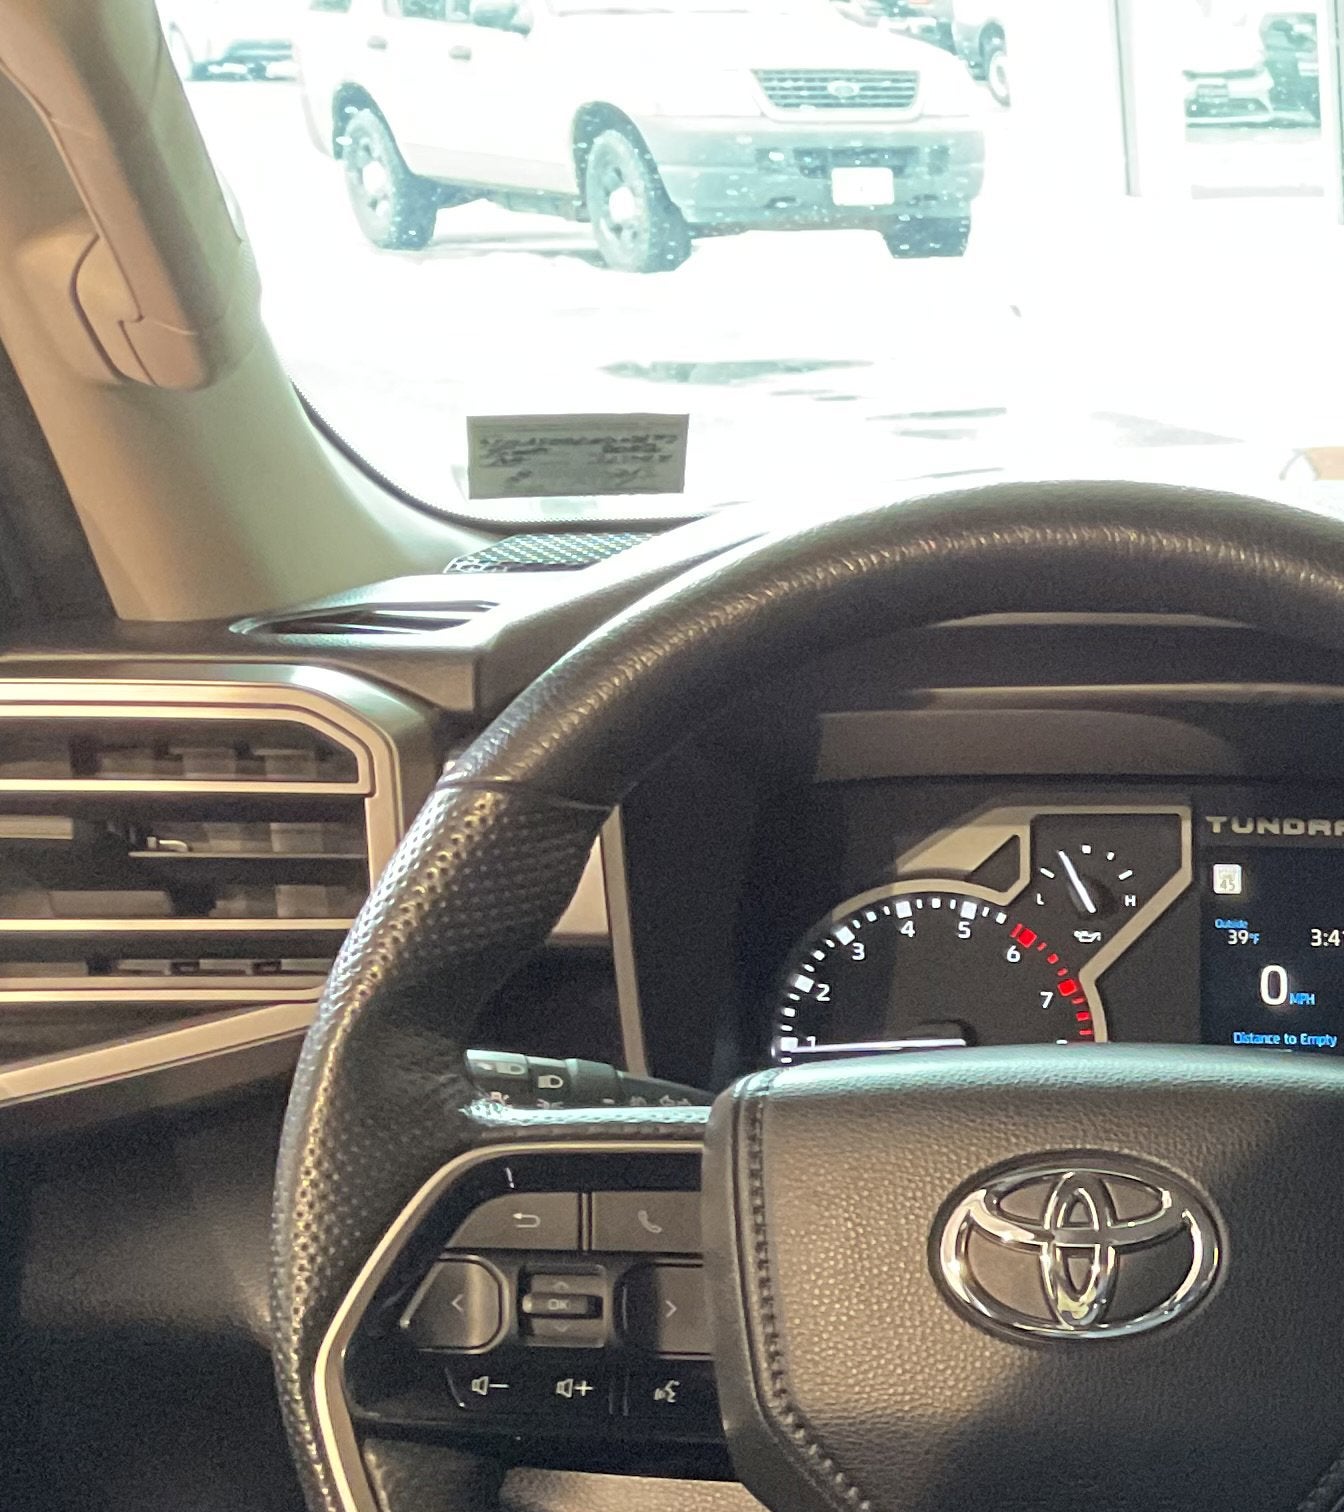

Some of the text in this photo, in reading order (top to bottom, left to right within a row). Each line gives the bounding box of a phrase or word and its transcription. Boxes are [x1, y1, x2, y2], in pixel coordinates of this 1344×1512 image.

[900, 920, 916, 938] 4
[958, 921, 972, 939] 5
[852, 942, 866, 961] 3
[1006, 945, 1021, 963] 6
[816, 984, 832, 1002] 2
[1260, 964, 1316, 1006] 0 MPH
[1040, 991, 1054, 1009] 7
[1232, 1031, 1338, 1048] Distance to Empty
[548, 1298, 571, 1310] OK
